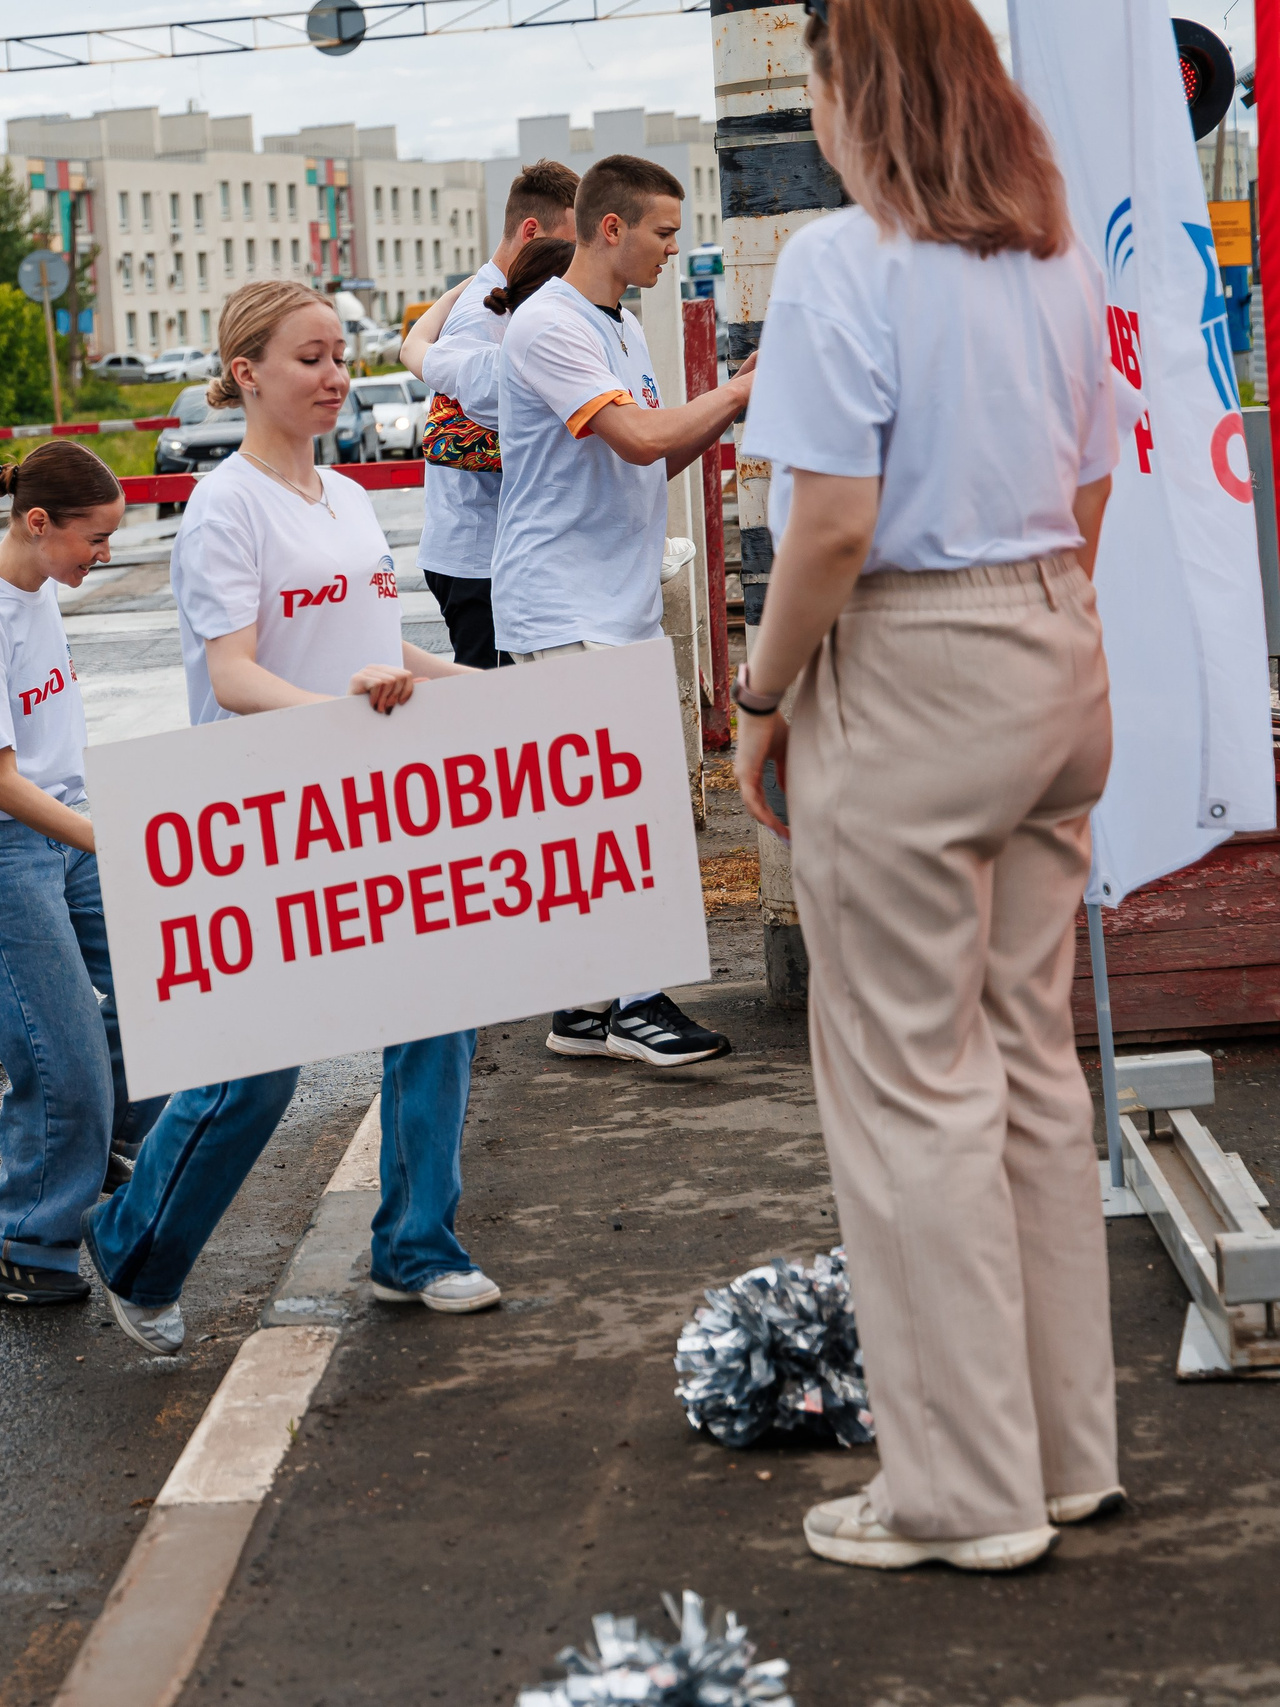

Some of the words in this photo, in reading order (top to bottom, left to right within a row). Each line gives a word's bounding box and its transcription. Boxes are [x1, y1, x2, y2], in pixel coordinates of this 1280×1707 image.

[144, 727, 644, 888] ОСТАНОВИСЬ
[156, 889, 255, 1002] ДО
[275, 822, 656, 963] ПЕРЕЕЗДА!
